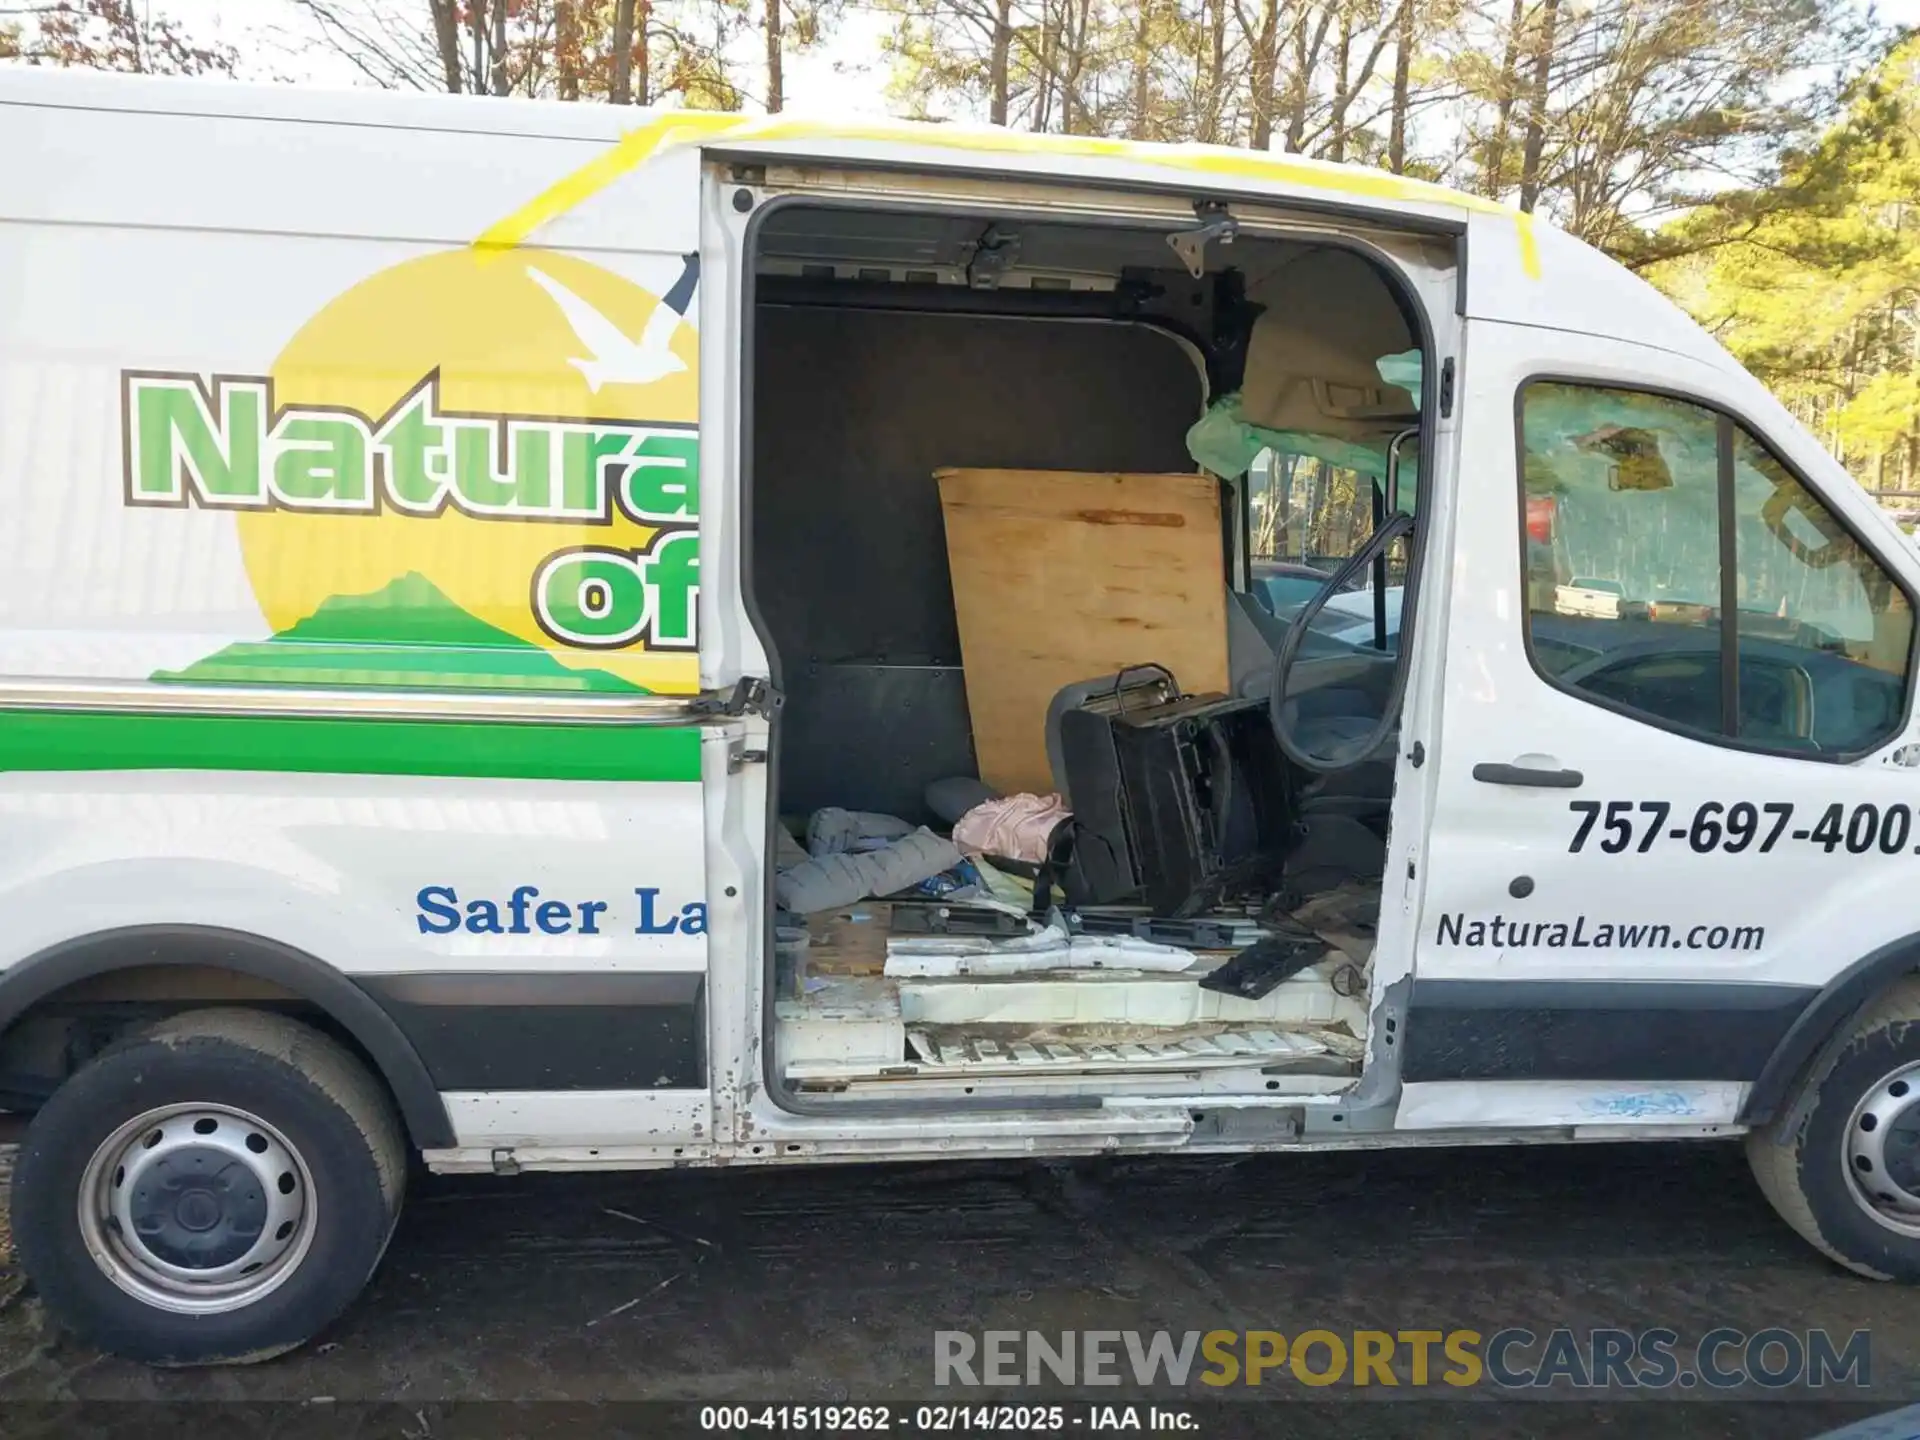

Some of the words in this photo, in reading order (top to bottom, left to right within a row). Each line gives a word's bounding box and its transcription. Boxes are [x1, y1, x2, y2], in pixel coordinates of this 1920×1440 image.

[121, 366, 699, 528] Natura
[530, 529, 699, 652] of
[1568, 801, 1920, 855] 757-697-400
[416, 886, 608, 934] Safer
[634, 887, 708, 934] La
[1436, 914, 1765, 950] NaturaLawn.com
